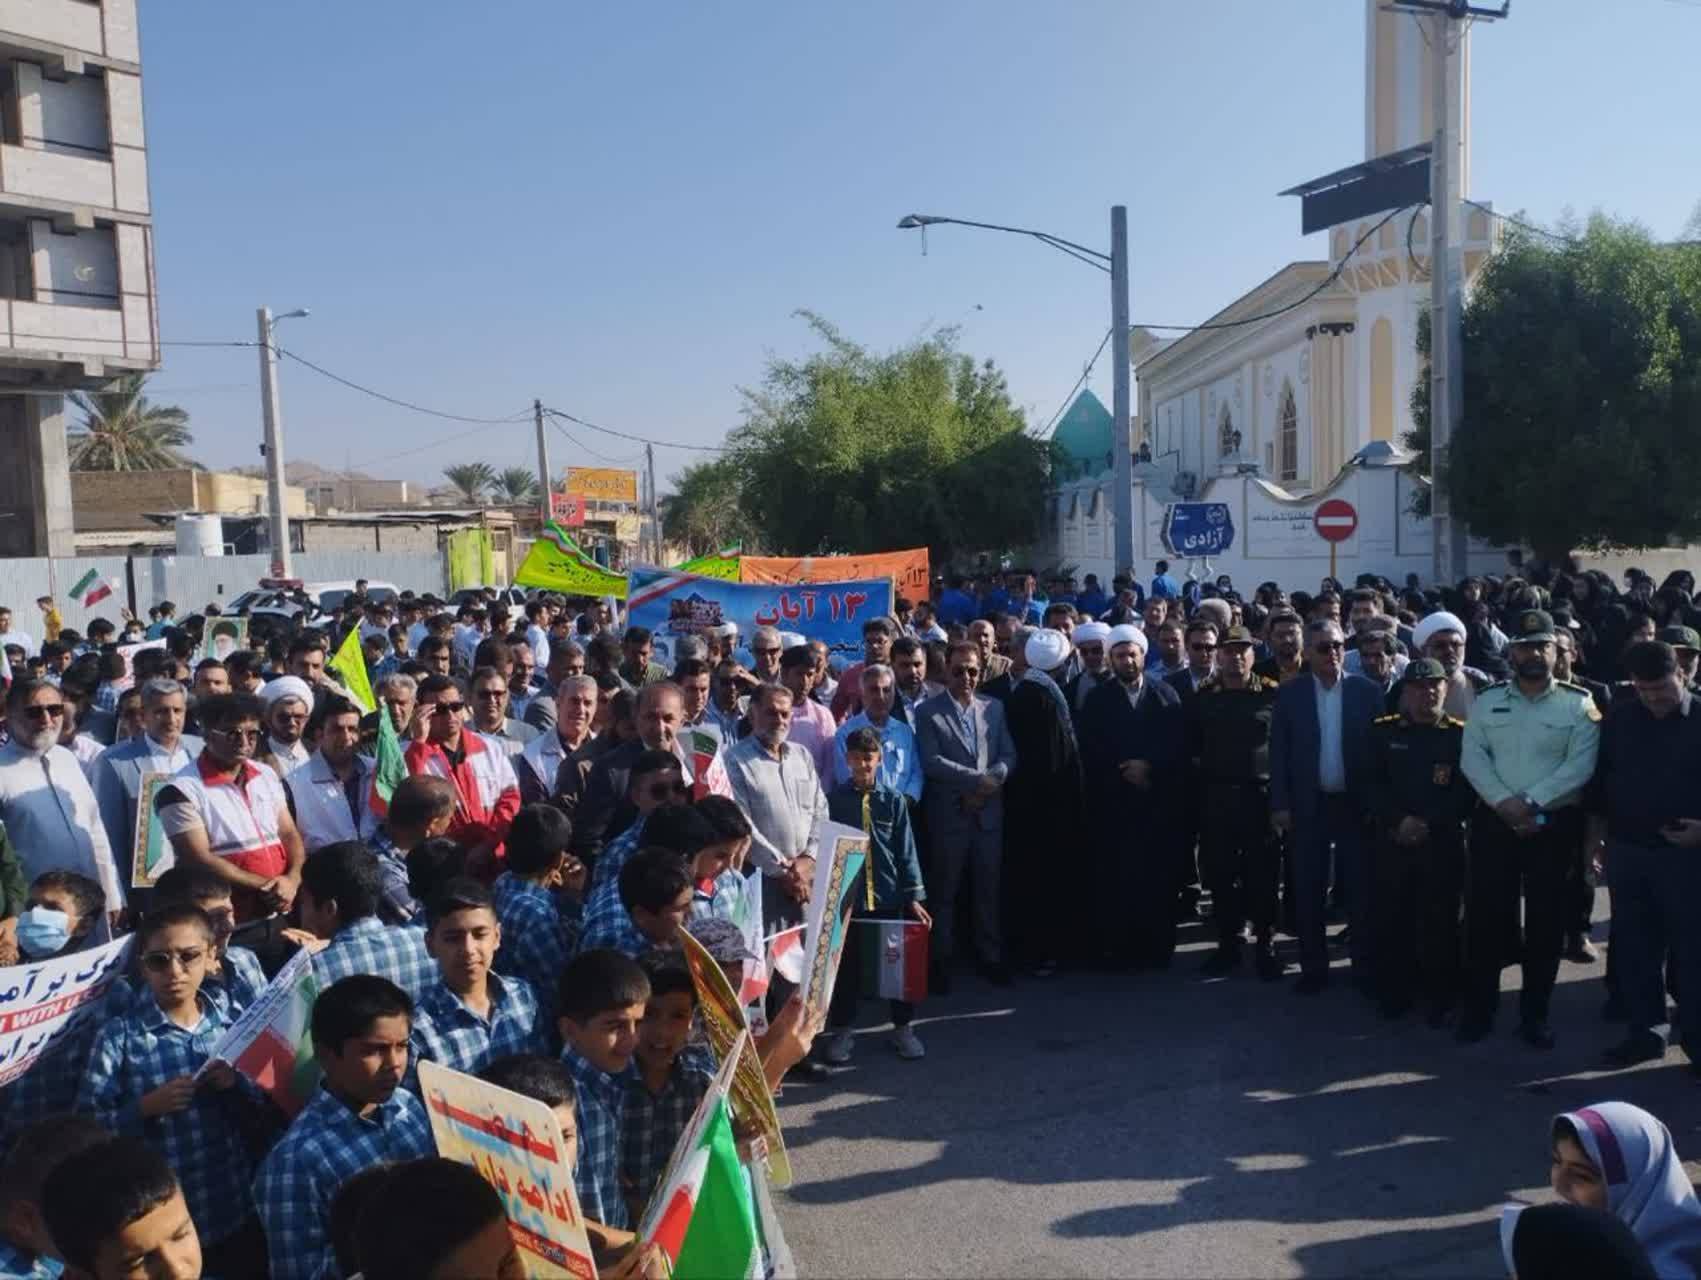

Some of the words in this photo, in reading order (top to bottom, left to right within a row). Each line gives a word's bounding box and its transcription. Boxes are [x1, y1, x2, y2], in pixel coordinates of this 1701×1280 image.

[1184, 527, 1224, 549] آزادی
[754, 591, 820, 626] آبان
[828, 591, 868, 623] ۱۳
